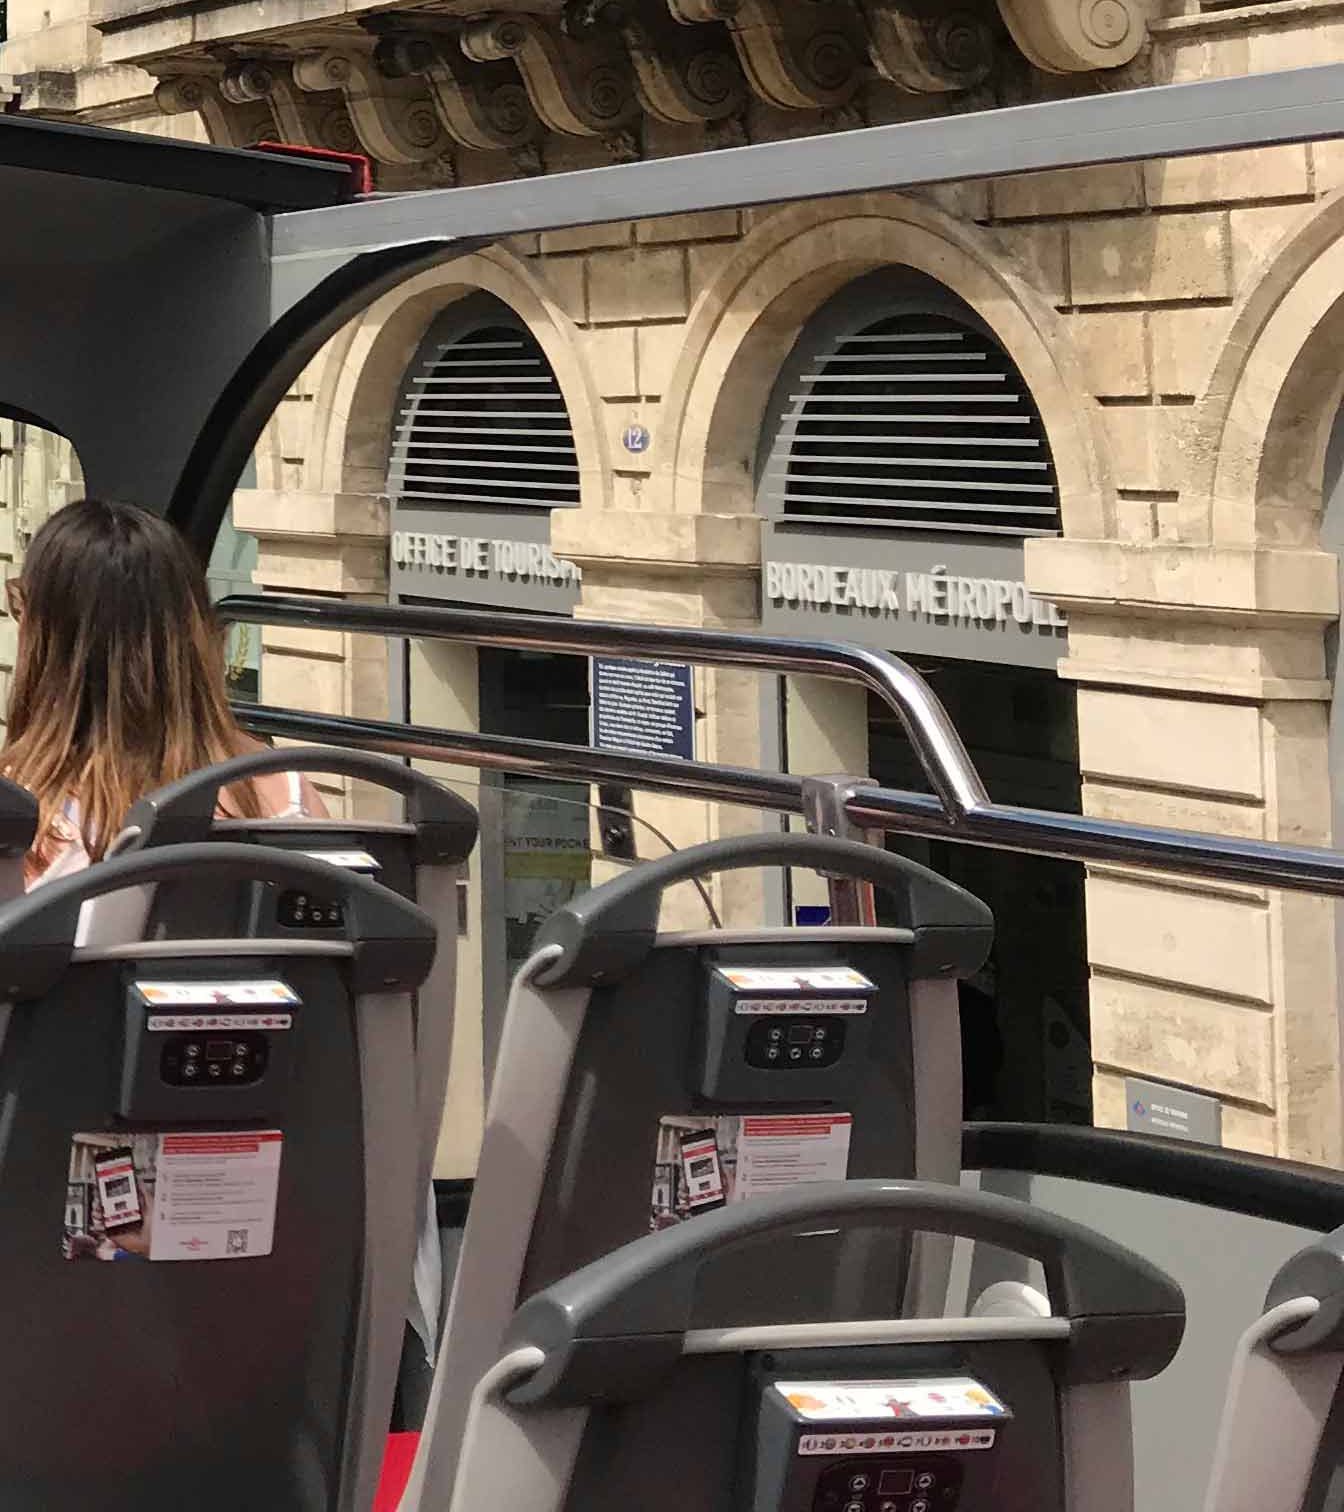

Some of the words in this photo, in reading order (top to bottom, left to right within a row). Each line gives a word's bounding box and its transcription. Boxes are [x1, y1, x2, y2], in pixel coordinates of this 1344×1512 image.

[628, 427, 642, 449] 12
[392, 531, 457, 567] OFFICE
[461, 537, 489, 571] DE
[491, 540, 582, 580] TOURIS
[767, 561, 899, 609] BORDEAUX
